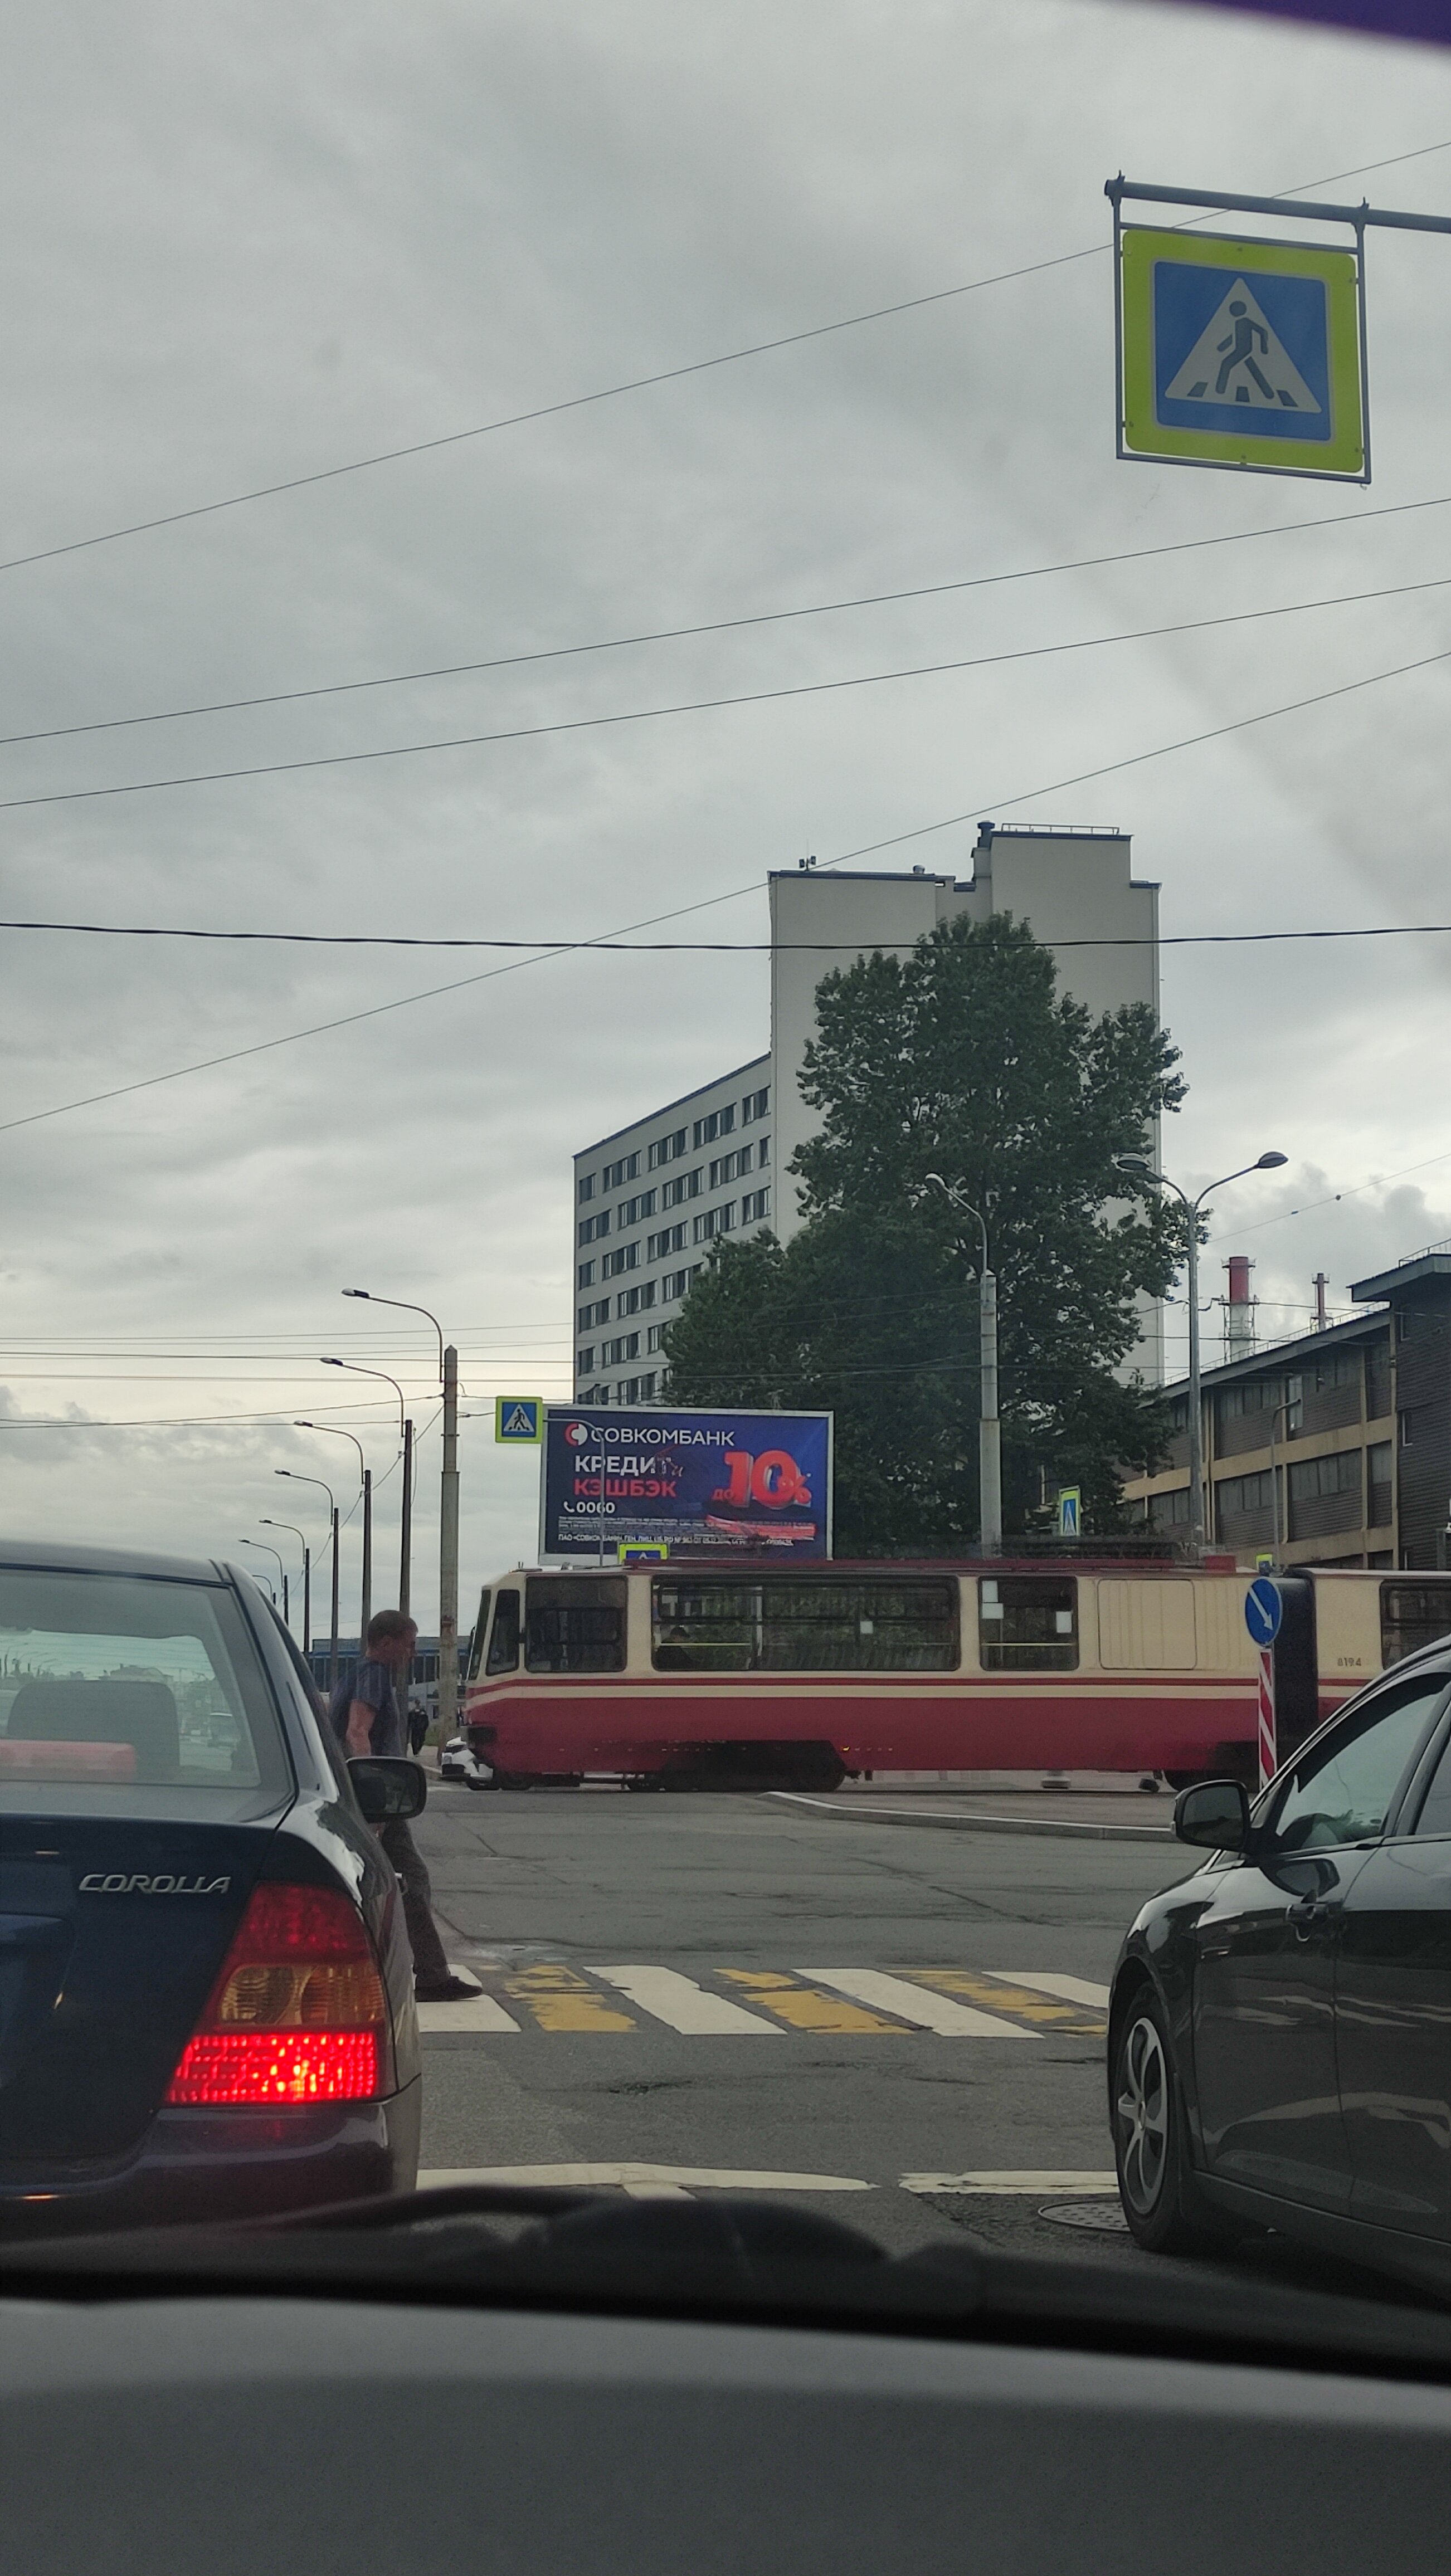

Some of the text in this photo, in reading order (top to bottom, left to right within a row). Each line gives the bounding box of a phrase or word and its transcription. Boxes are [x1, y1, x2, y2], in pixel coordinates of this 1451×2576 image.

[591, 1427, 735, 1447] СОВКОМБАНК
[574, 1478, 678, 1498] КЭШБЭК
[576, 1501, 616, 1514] 0060
[79, 1874, 231, 1894] COROLLA
